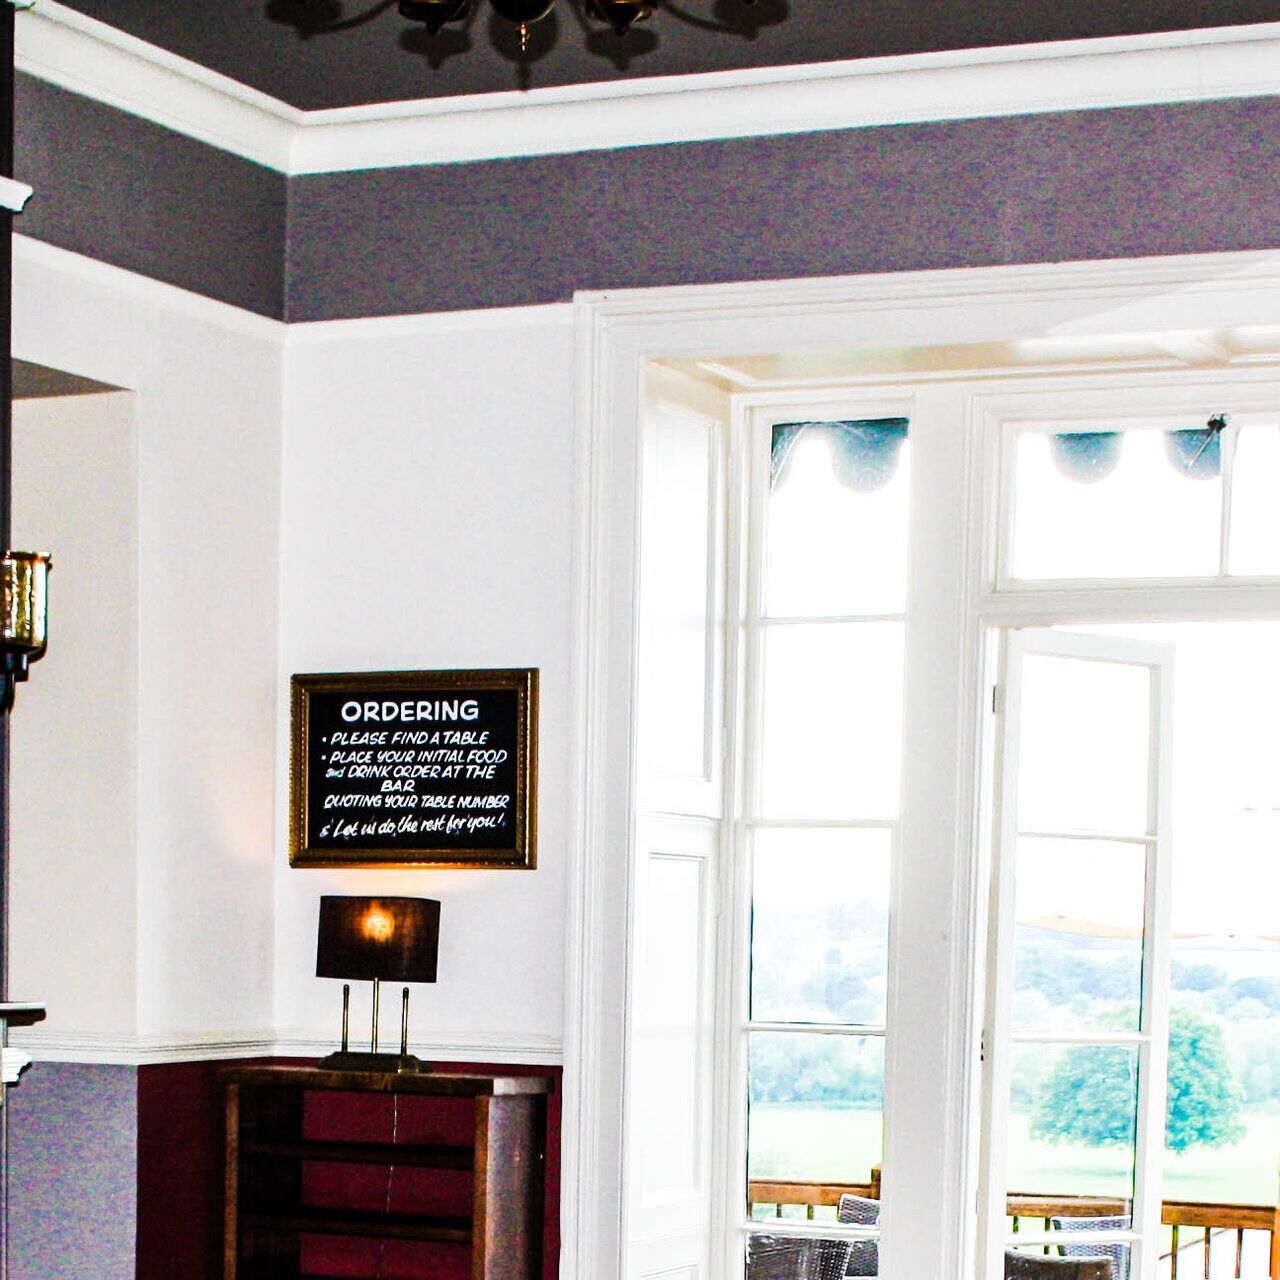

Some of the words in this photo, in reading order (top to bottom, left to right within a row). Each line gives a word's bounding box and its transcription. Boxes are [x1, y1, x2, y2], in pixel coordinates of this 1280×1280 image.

[341, 700, 479, 721] ORDERING
[330, 731, 389, 745] PLEASE
[391, 731, 429, 745] FIND
[429, 731, 440, 745] A
[443, 731, 490, 745] TABLE
[329, 750, 373, 764] PLACE
[377, 750, 415, 763] YOUR
[417, 749, 465, 763] INITIAL
[467, 749, 508, 764] FOOD
[347, 765, 392, 778] DRINK
[393, 765, 441, 778] ORDER
[441, 765, 464, 778] AT
[466, 765, 496, 779] THE
[381, 779, 415, 792] BAR
[323, 794, 383, 809] QUOTING
[384, 794, 418, 808] YOUR
[421, 794, 456, 808] TABLE
[457, 794, 509, 808] NUMBER
[333, 818, 359, 837] Let
[378, 818, 396, 834] do
[397, 814, 418, 833] the
[420, 814, 446, 831] rest
[446, 814, 467, 833] for
[467, 812, 504, 833] you!
